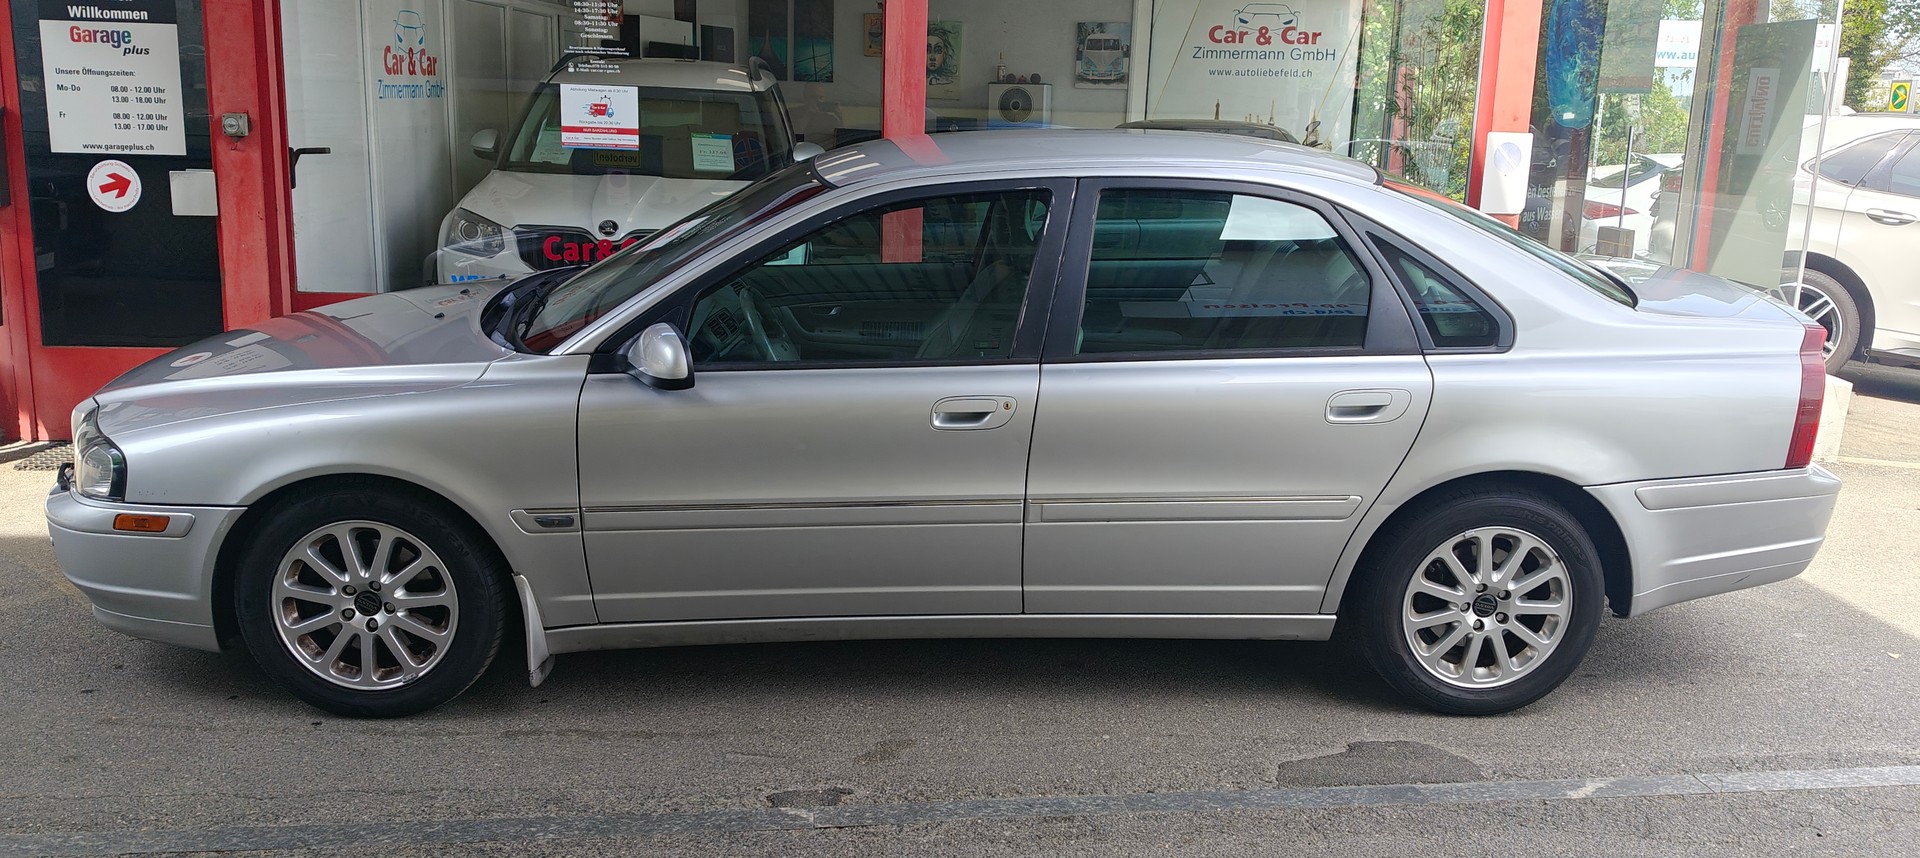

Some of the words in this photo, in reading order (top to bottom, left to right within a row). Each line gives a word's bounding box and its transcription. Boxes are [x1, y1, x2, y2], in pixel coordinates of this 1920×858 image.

[67, 5, 148, 20] Willkommen
[69, 25, 132, 48] Garage
[1208, 25, 1248, 44] Car
[1255, 26, 1272, 46] &
[1280, 26, 1322, 45] Car
[123, 45, 150, 56] plus
[1192, 46, 1285, 61] Zimmermann
[1290, 48, 1336, 61] GmbH
[384, 45, 405, 76] Car
[407, 46, 417, 76] &
[419, 48, 438, 76] Car
[55, 67, 81, 76] Unsere
[82, 66, 136, 77] Öffnungszeiten:
[1208, 68, 1313, 78] www.autoliebefeld.ch
[56, 84, 81, 92] Mo-Do
[110, 85, 128, 93] 08.00
[134, 86, 152, 94] 12.00
[153, 86, 166, 94] Uhr
[377, 79, 424, 99] Zimmermann
[425, 80, 446, 99] GmbH
[136, 113, 154, 121] 12.00
[155, 113, 168, 121] Uhr
[82, 143, 155, 152] www.garageplus.ch
